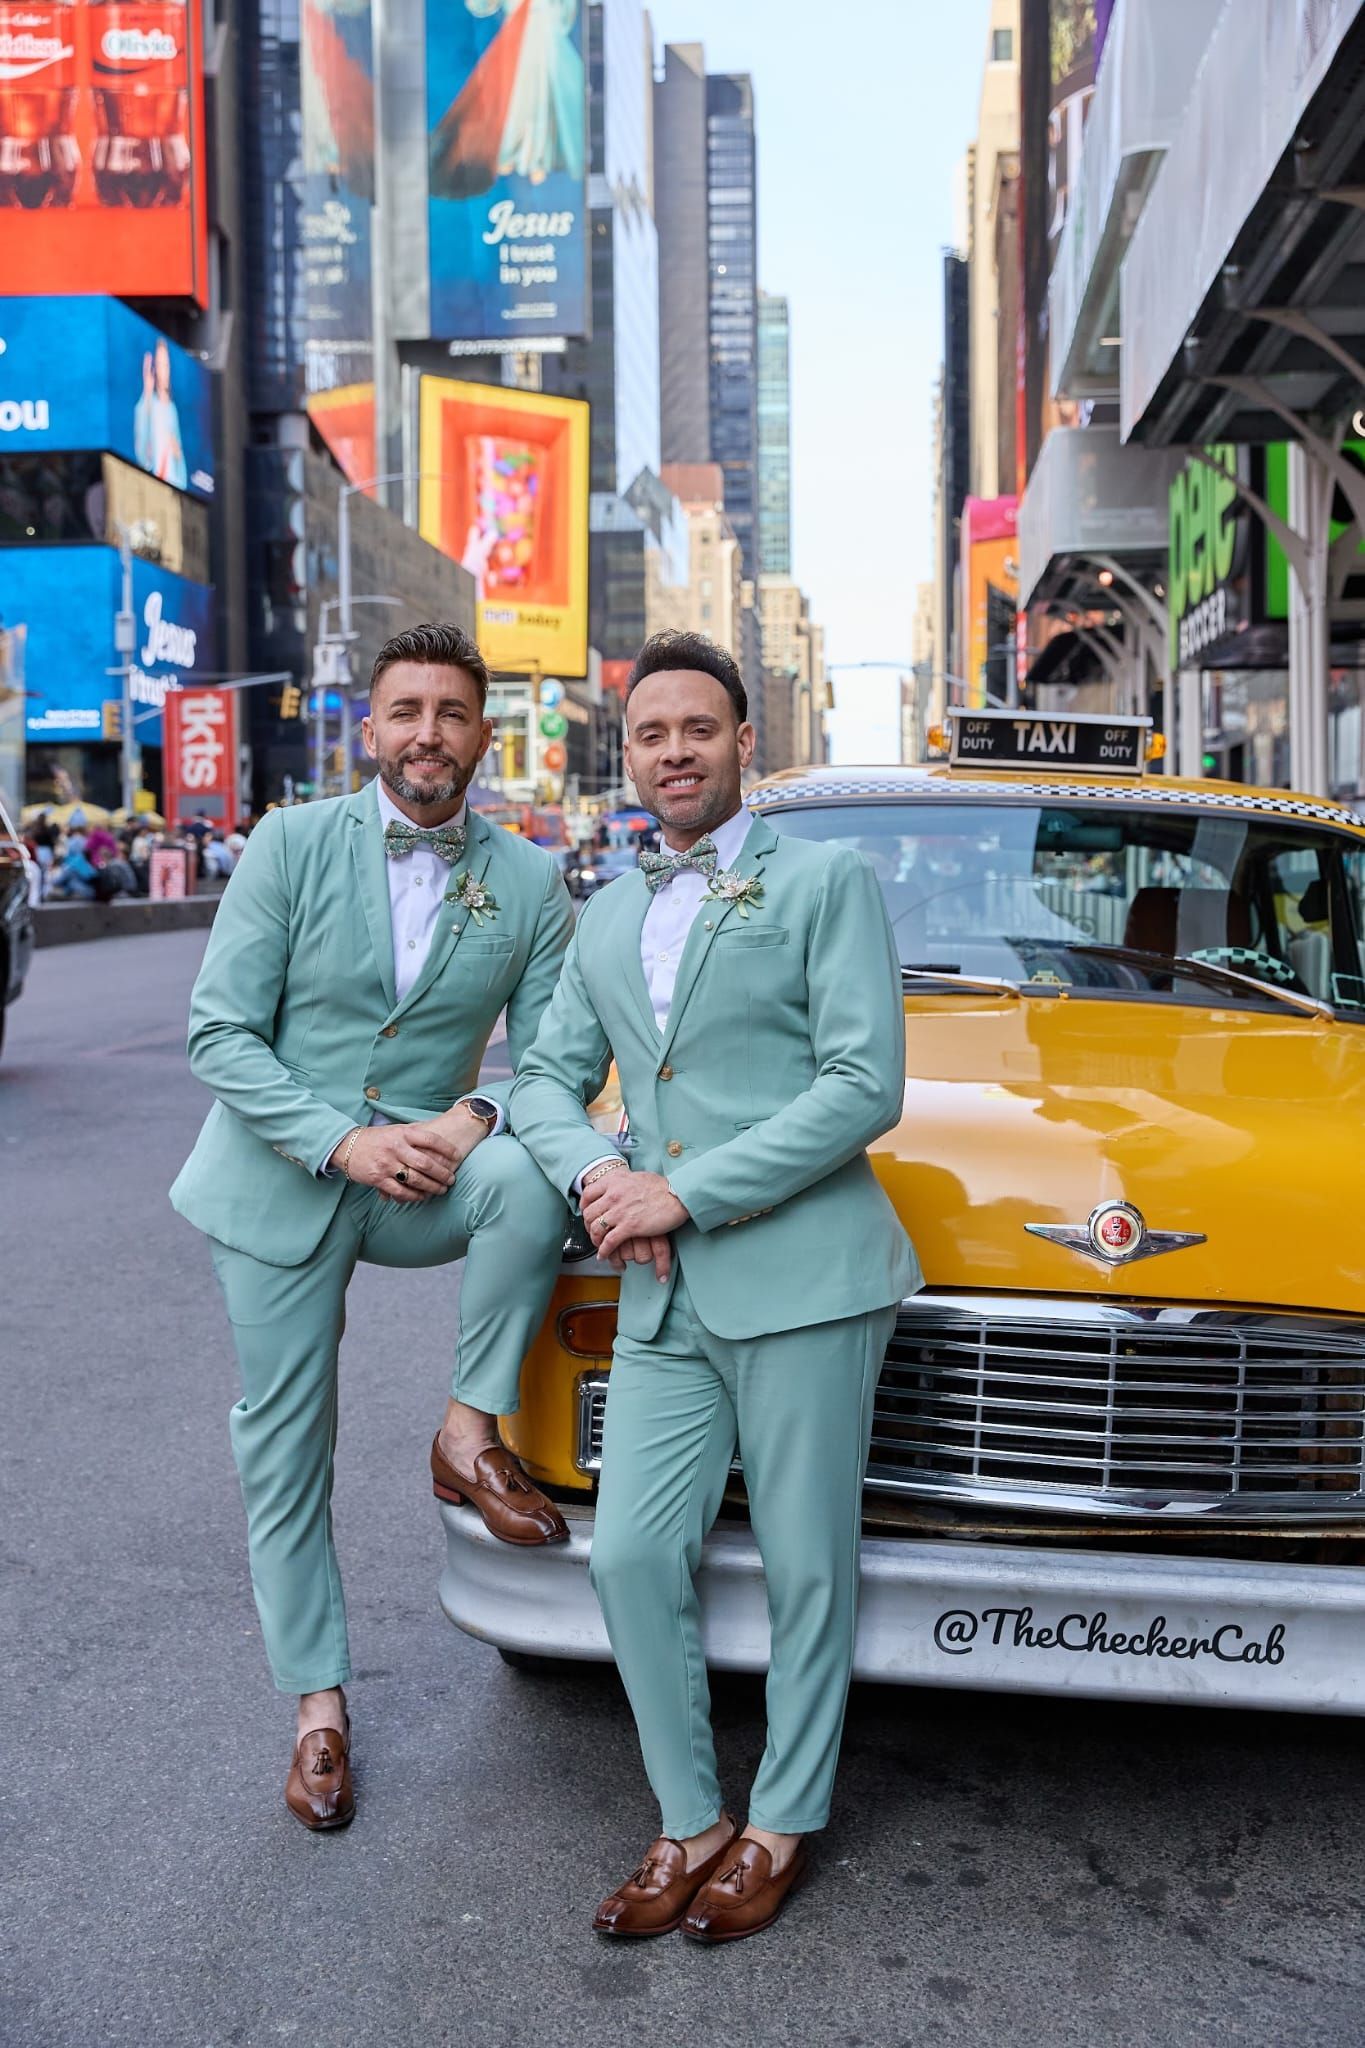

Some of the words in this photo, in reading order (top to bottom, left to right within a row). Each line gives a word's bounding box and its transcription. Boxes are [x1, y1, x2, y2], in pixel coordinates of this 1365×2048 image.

[482, 200, 575, 245] Jesus
[500, 244, 509, 263] I
[510, 243, 555, 263] trust
[500, 264, 520, 284] in
[521, 266, 557, 287] you
[141, 591, 196, 668] Jesus
[1180, 588, 1226, 664] SOCCER
[181, 693, 226, 789] tkts
[966, 721, 991, 734] OFF
[1013, 721, 1077, 754] TAXI
[1104, 729, 1129, 742] OFF
[961, 737, 994, 750] DUTY
[1099, 745, 1133, 759] DUTY
[933, 1606, 1286, 1665] @TheCheckerCab
